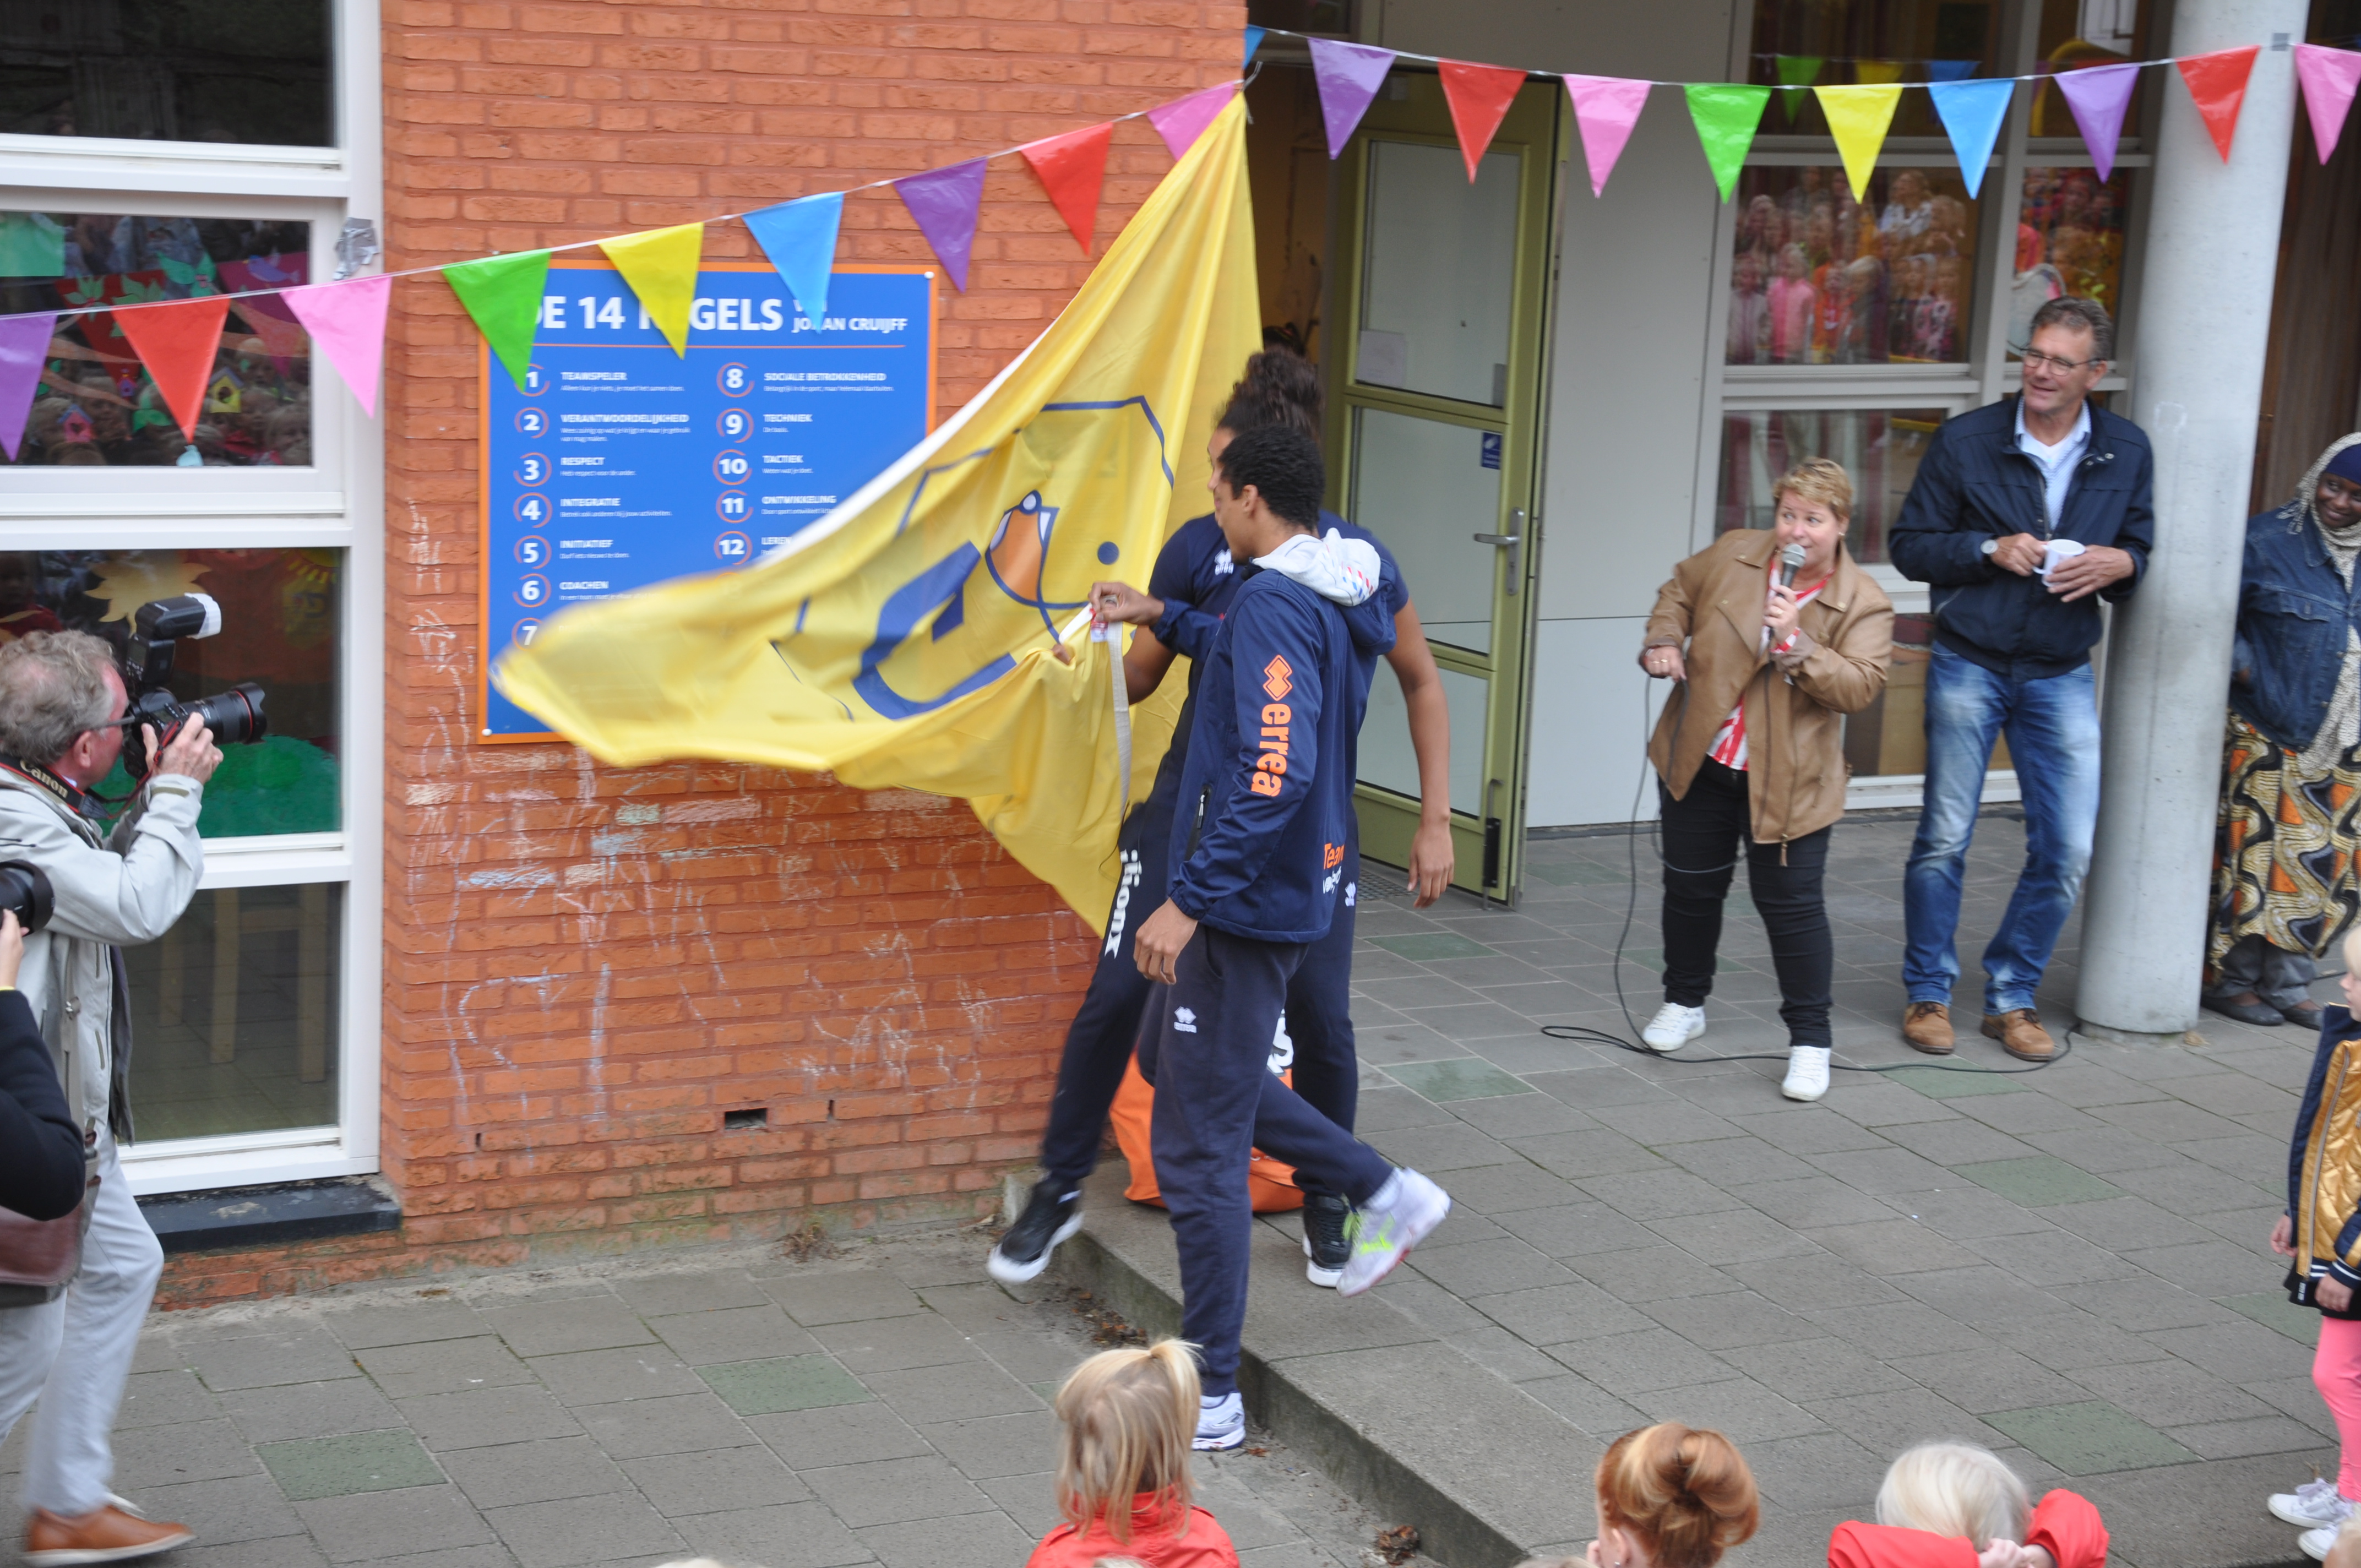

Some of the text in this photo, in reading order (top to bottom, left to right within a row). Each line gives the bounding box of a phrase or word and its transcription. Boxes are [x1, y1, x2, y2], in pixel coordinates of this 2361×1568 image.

[535, 296, 784, 331] E 14 GELS
[791, 317, 908, 333] JOAN CRUIJFF
[526, 371, 538, 388] 1
[561, 372, 628, 380] TEAMSPELER
[726, 368, 743, 388] 8
[764, 373, 886, 381] SOCIALE BETROKKENHEID
[524, 415, 540, 431] 2
[561, 415, 689, 424] VERANTWOORDELIJKHEID
[725, 414, 743, 434] 9
[763, 414, 813, 422] TECHNIEK
[561, 457, 605, 466] RESPECT
[719, 458, 748, 475] 10
[762, 455, 803, 463] TACTIEK
[524, 459, 540, 480] 3
[561, 498, 621, 507] INTEGRATIE
[722, 498, 744, 513] 11
[761, 496, 837, 504] ONTWIKKELING
[521, 500, 541, 520] 4
[560, 540, 613, 548] INITIATIEF
[719, 538, 745, 555] 12
[523, 542, 540, 563] 5
[522, 580, 540, 601] 6
[559, 581, 609, 590] COACHEN
[522, 625, 538, 646] 7
[20, 759, 68, 798] Canon
